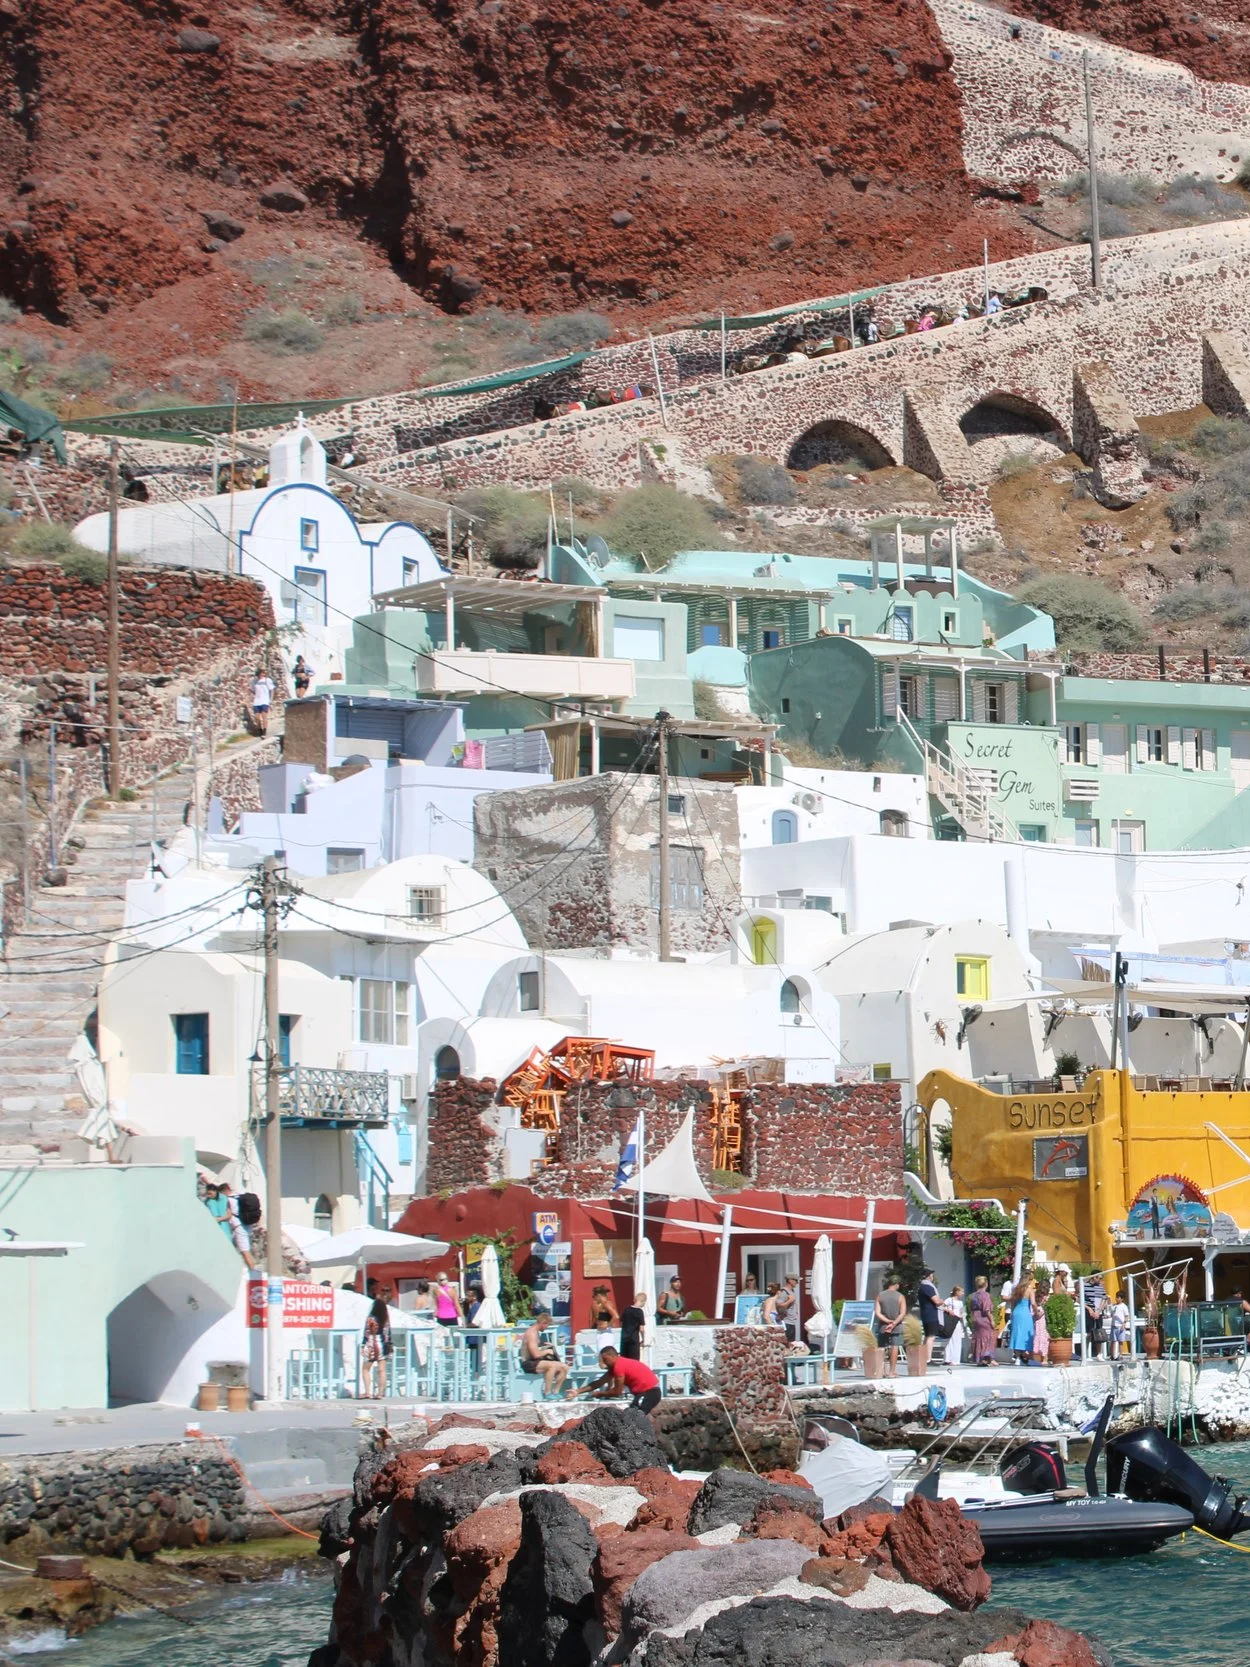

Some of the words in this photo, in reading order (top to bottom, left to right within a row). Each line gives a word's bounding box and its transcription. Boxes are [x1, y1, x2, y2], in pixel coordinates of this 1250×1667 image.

[964, 732, 1014, 759] Secret
[998, 769, 1034, 803] Gem
[1028, 799, 1056, 811] Suites
[539, 1214, 556, 1223] ATM
[281, 1284, 333, 1294] ANTORINI
[281, 1298, 332, 1311] ISHING
